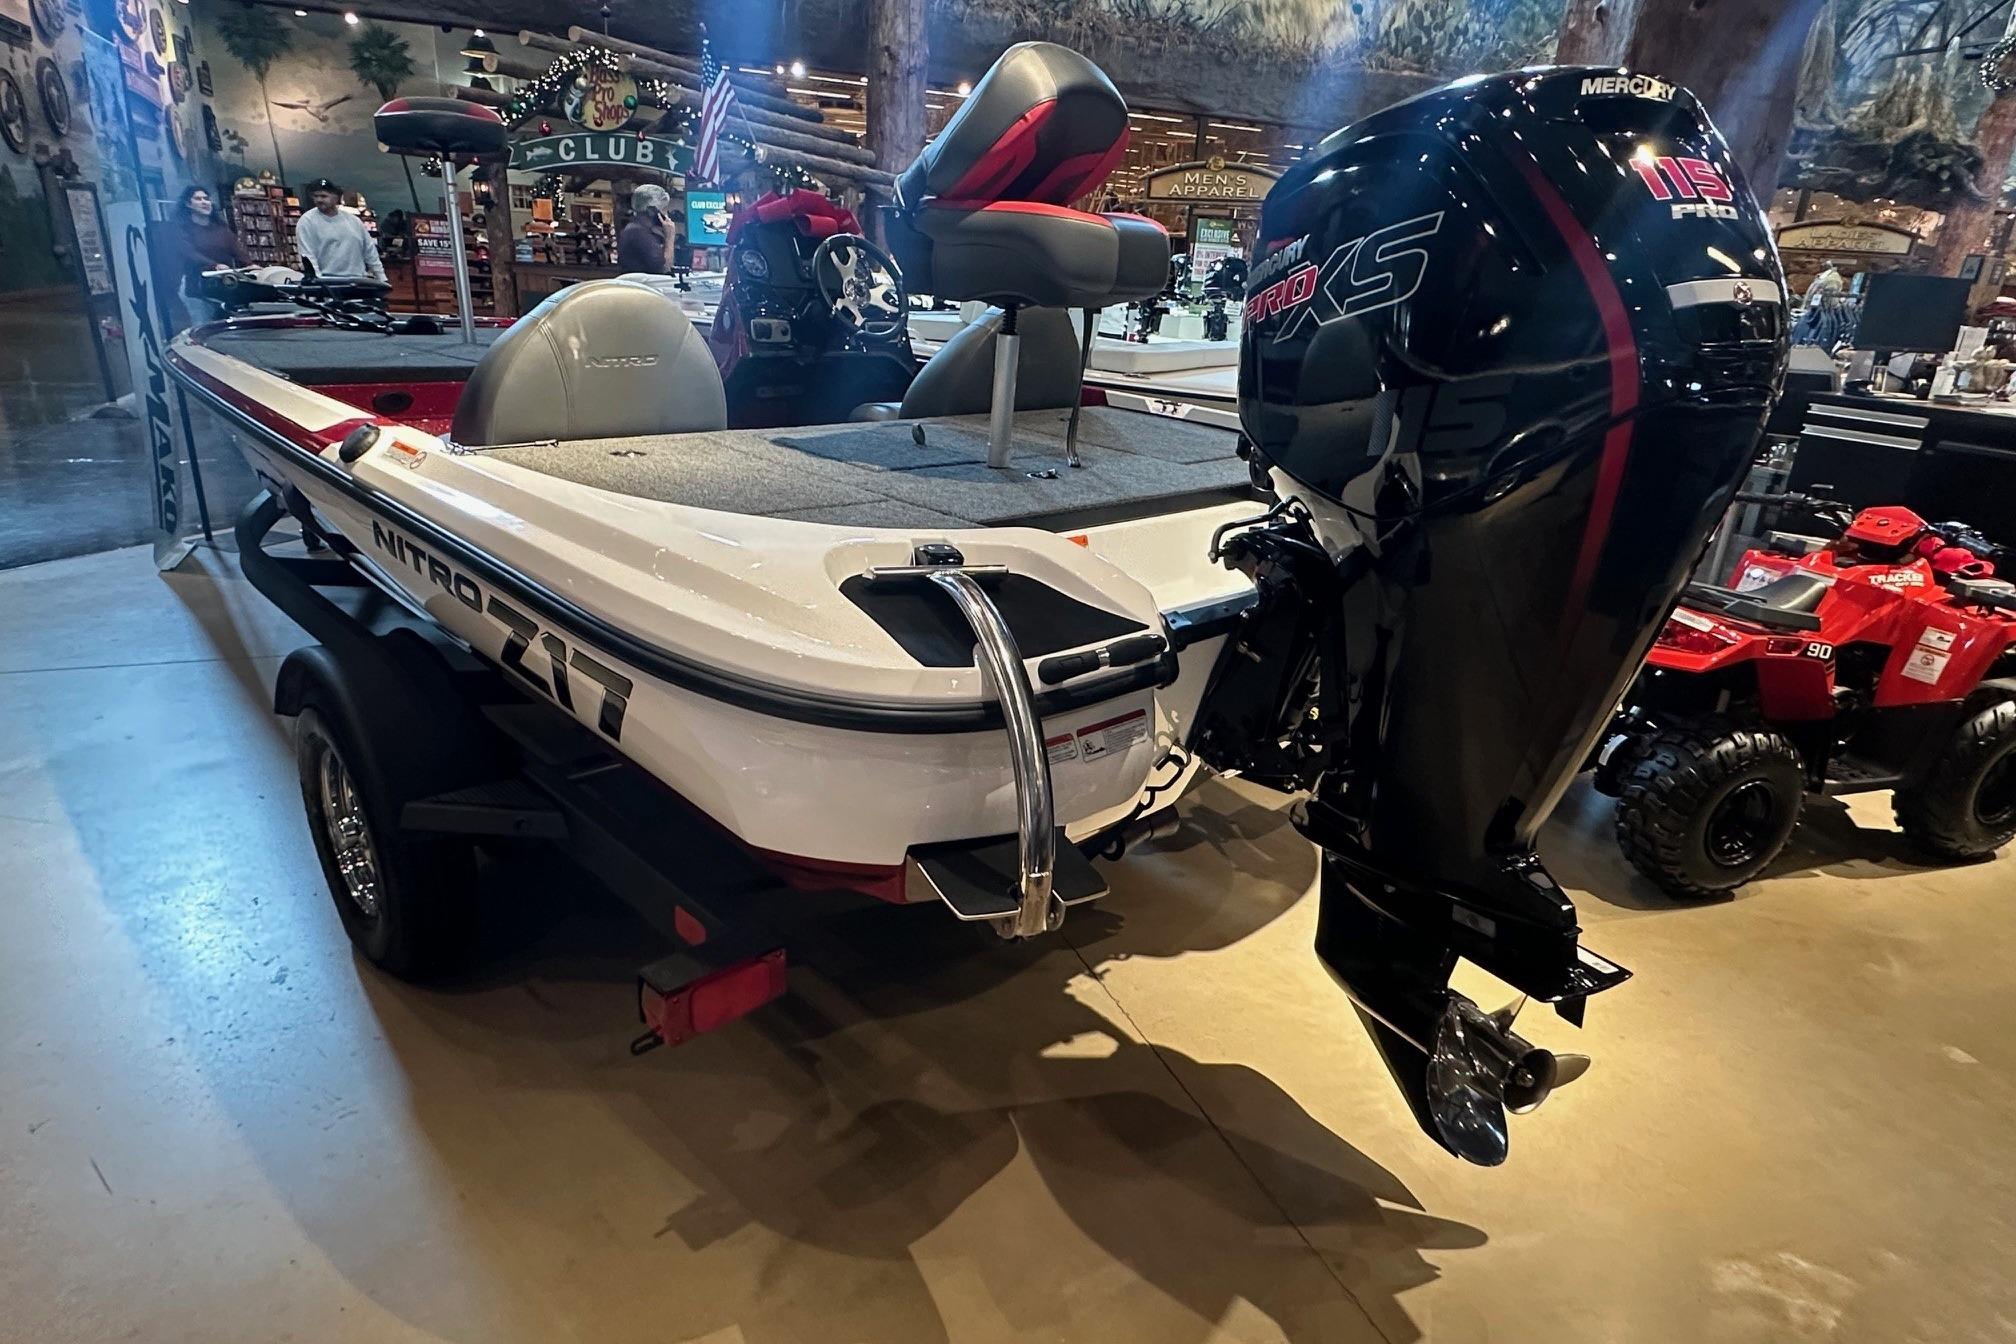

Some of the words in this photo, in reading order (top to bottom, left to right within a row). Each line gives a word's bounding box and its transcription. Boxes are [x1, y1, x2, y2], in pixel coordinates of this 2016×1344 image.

[593, 84, 615, 102] Pro
[1580, 76, 1676, 100] MERCURY
[592, 101, 630, 127] Shops
[558, 137, 654, 163] CLUB
[1184, 172, 1247, 185] MEN'S
[1628, 156, 1733, 201] 115
[1169, 184, 1260, 198] APPAREL
[691, 201, 706, 209] CLUB
[1670, 203, 1739, 220] PRO
[418, 239, 438, 247] SAVE
[1794, 239, 1889, 251] APPAREL
[143, 338, 178, 534] MAKO
[372, 519, 483, 613] NITRO
[1807, 643, 1833, 660] 90
